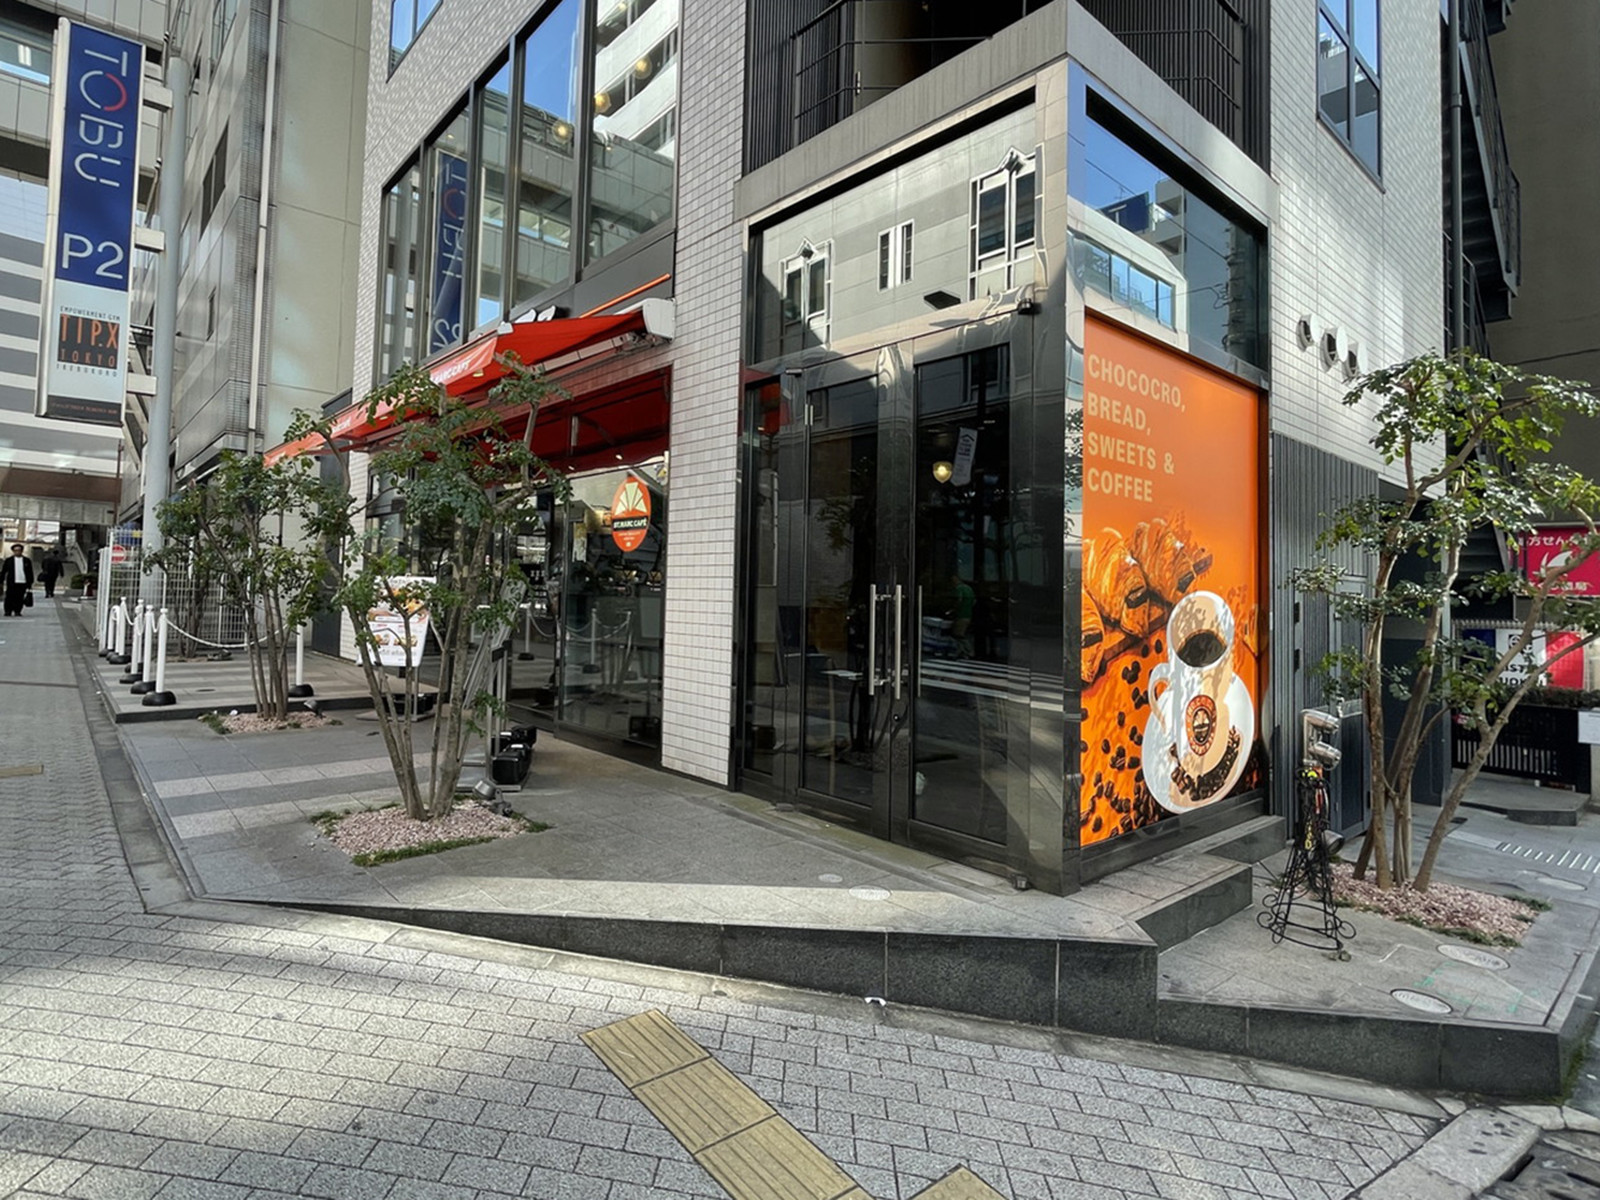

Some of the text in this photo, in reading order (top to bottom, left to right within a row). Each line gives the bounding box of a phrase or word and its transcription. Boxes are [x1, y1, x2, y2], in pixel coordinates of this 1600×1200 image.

[62, 232, 124, 279] P2
[60, 348, 116, 368] TOKYO
[1088, 354, 1186, 413] CHOCOCRO,
[1087, 391, 1151, 436] BREAD,
[1088, 431, 1175, 475] SWEETS &
[1087, 467, 1153, 502] COFFEE
